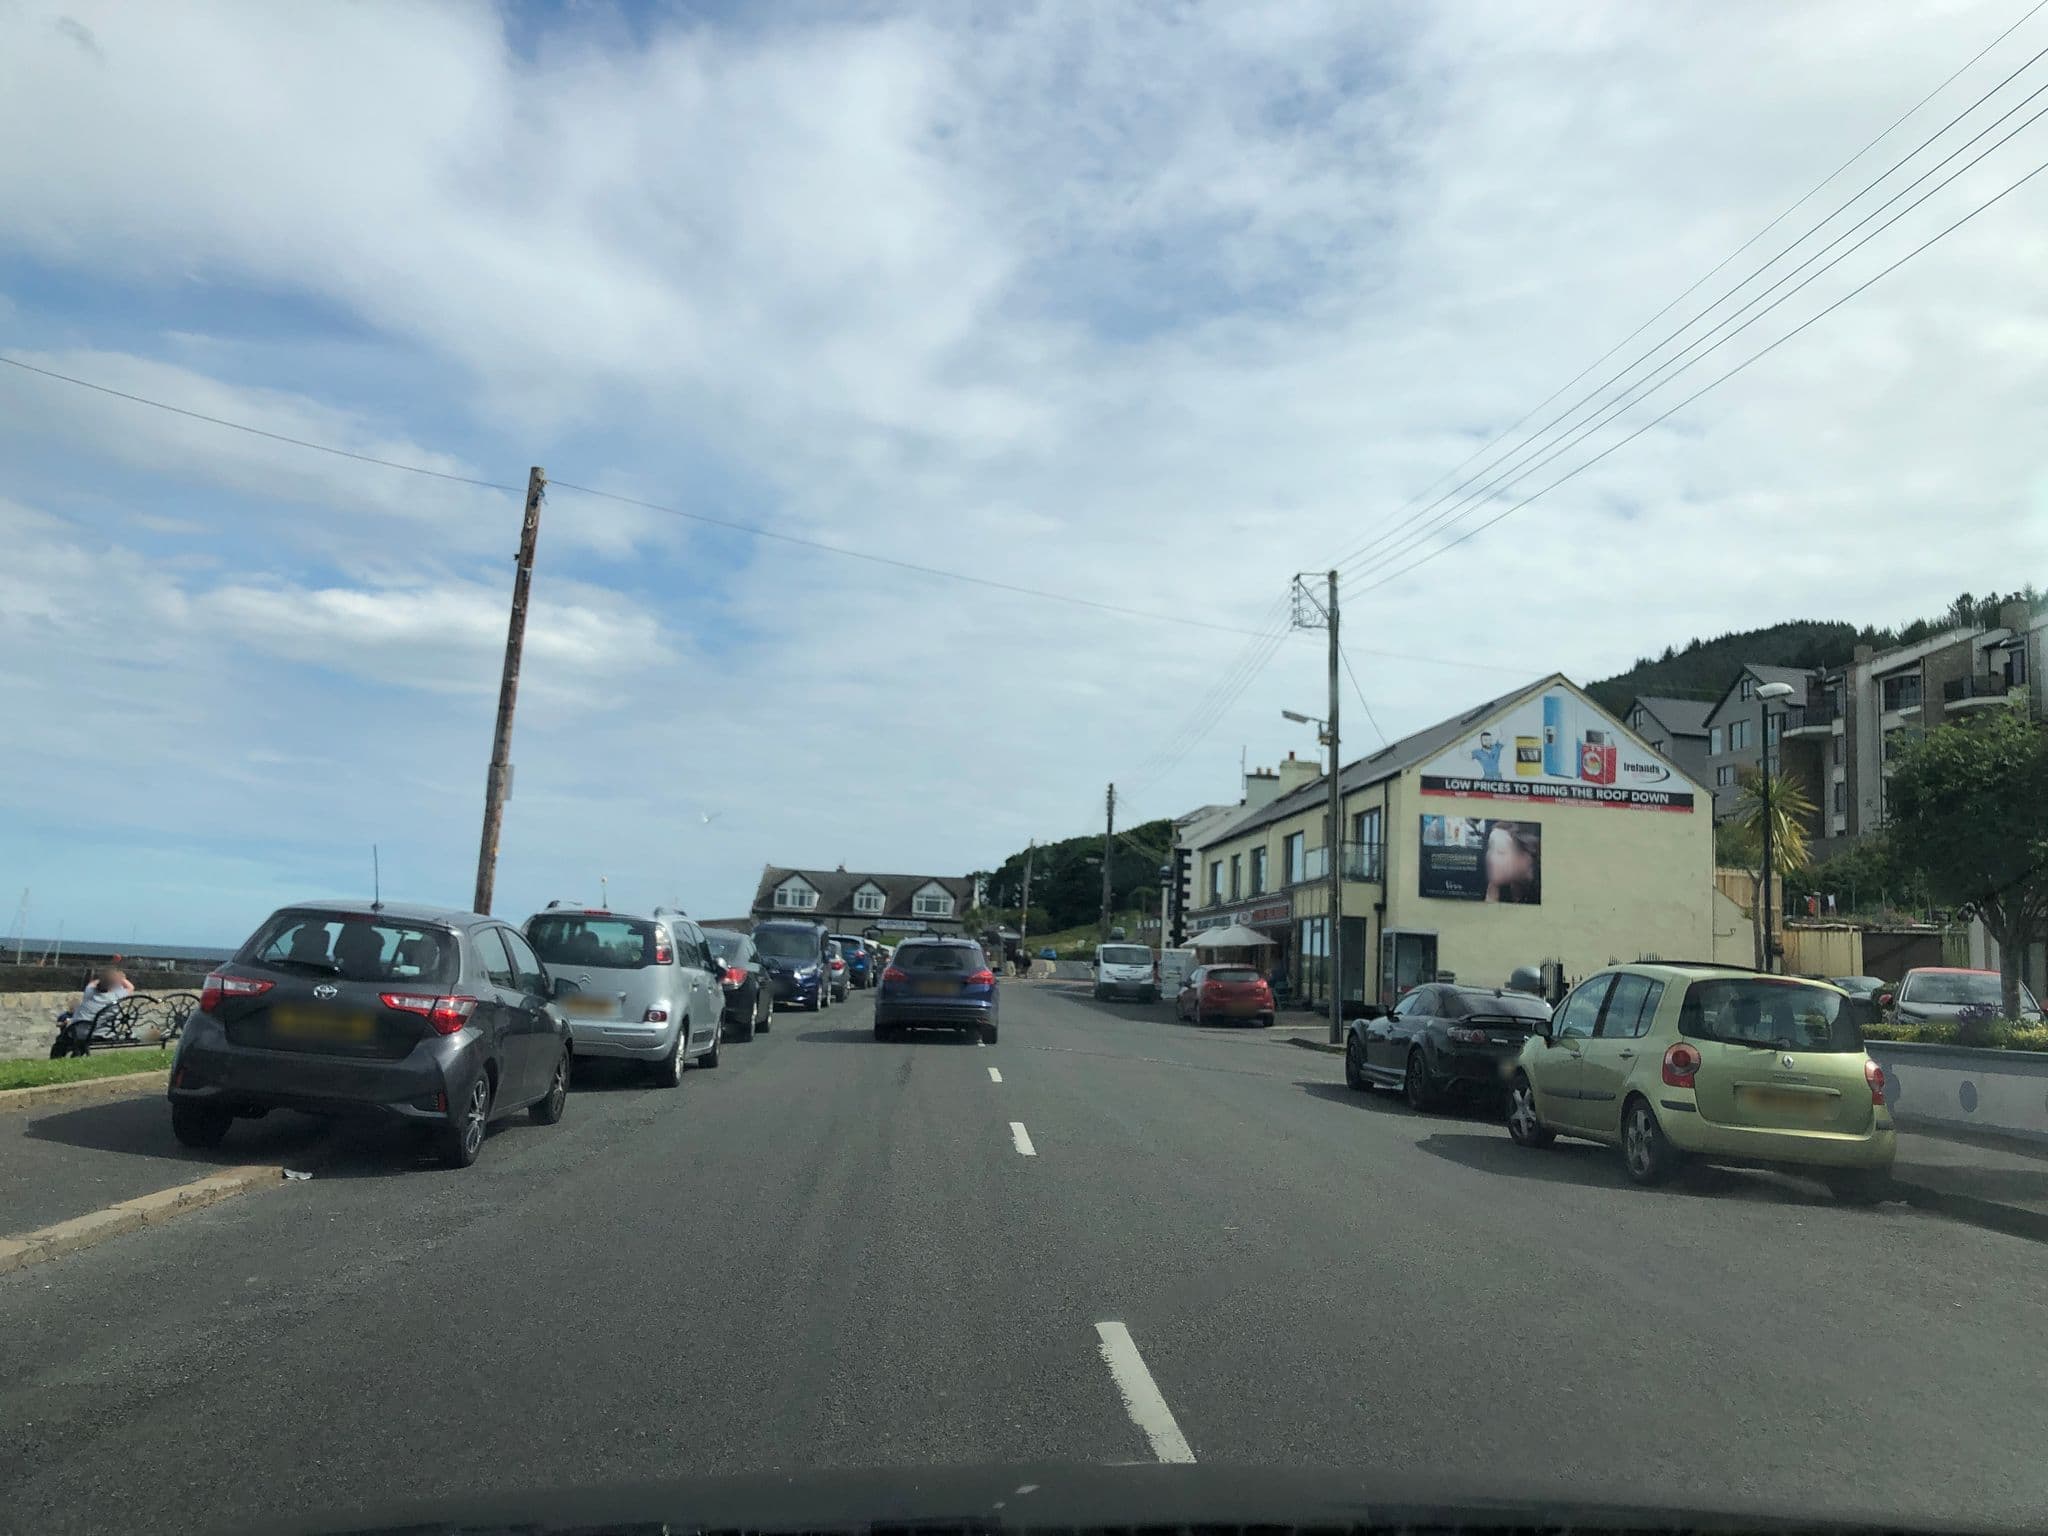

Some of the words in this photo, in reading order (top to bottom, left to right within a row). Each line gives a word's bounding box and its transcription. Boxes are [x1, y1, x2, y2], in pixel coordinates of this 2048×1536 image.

[1445, 779, 1471, 790] LOW
[1473, 780, 1511, 793] PRICES
[1514, 782, 1530, 794] TO
[1532, 783, 1568, 797] BRING
[1570, 786, 1594, 799] THE
[1596, 788, 1629, 801] ROOF
[1631, 791, 1669, 804] DOWN
